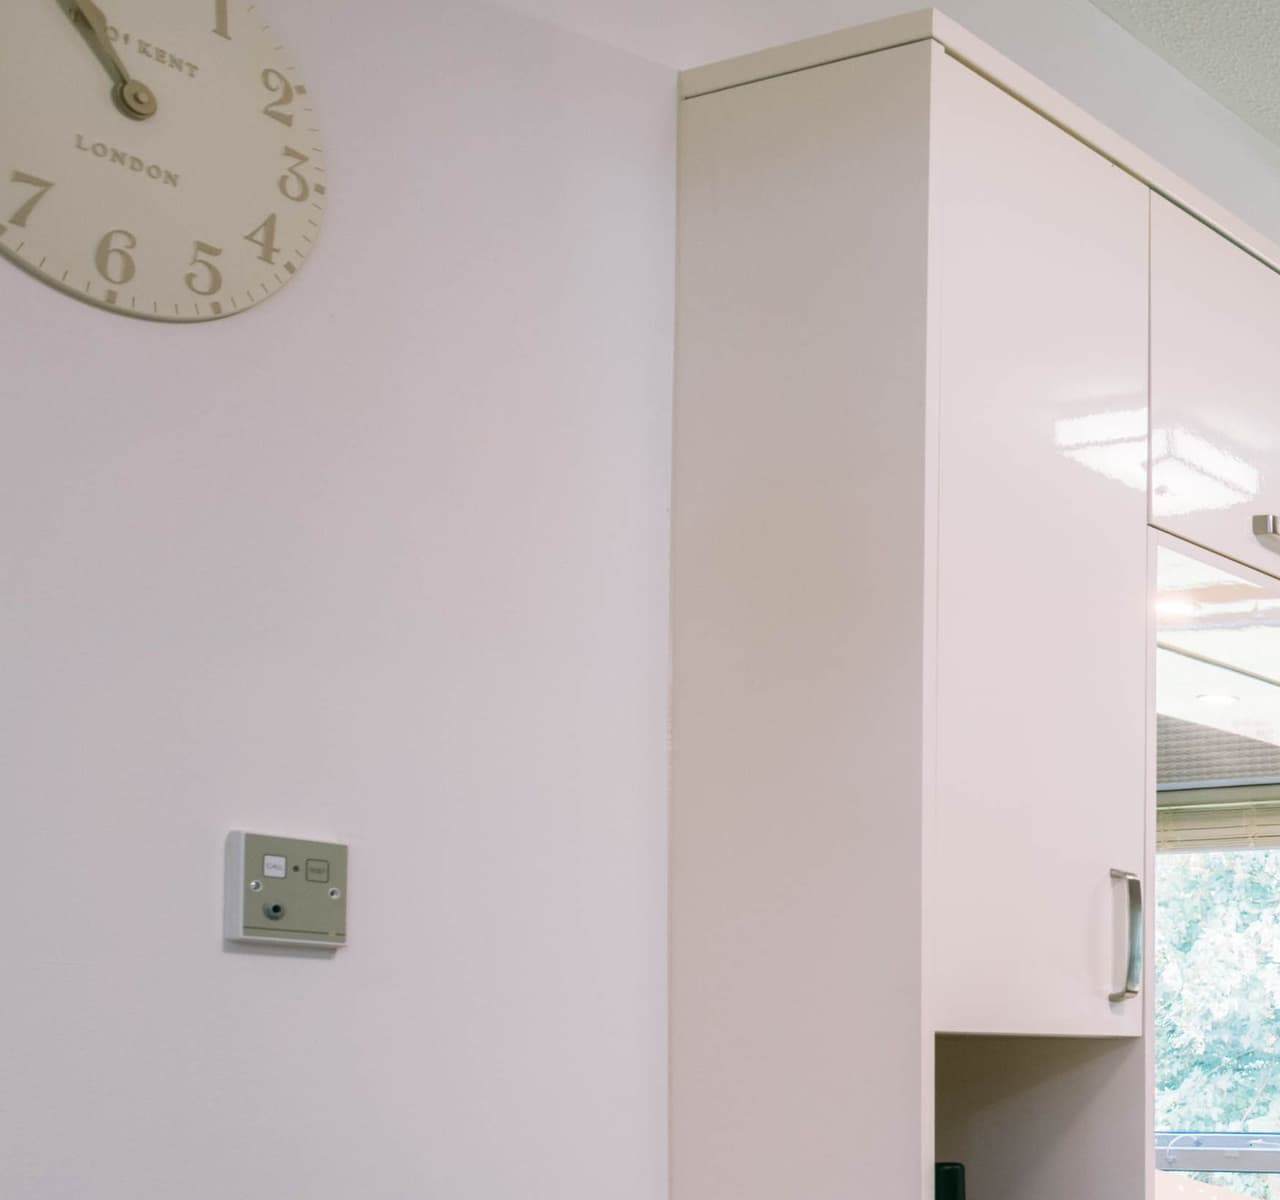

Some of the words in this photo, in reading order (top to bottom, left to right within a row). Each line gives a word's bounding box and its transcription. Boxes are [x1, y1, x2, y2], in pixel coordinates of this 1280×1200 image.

[137, 38, 199, 79] KENT
[261, 68, 295, 127] 2
[74, 133, 180, 188] LONDON
[277, 145, 310, 203] 3
[8, 170, 55, 228] 7
[95, 229, 137, 285] 6
[243, 212, 280, 266] 4
[184, 240, 224, 296] 5
